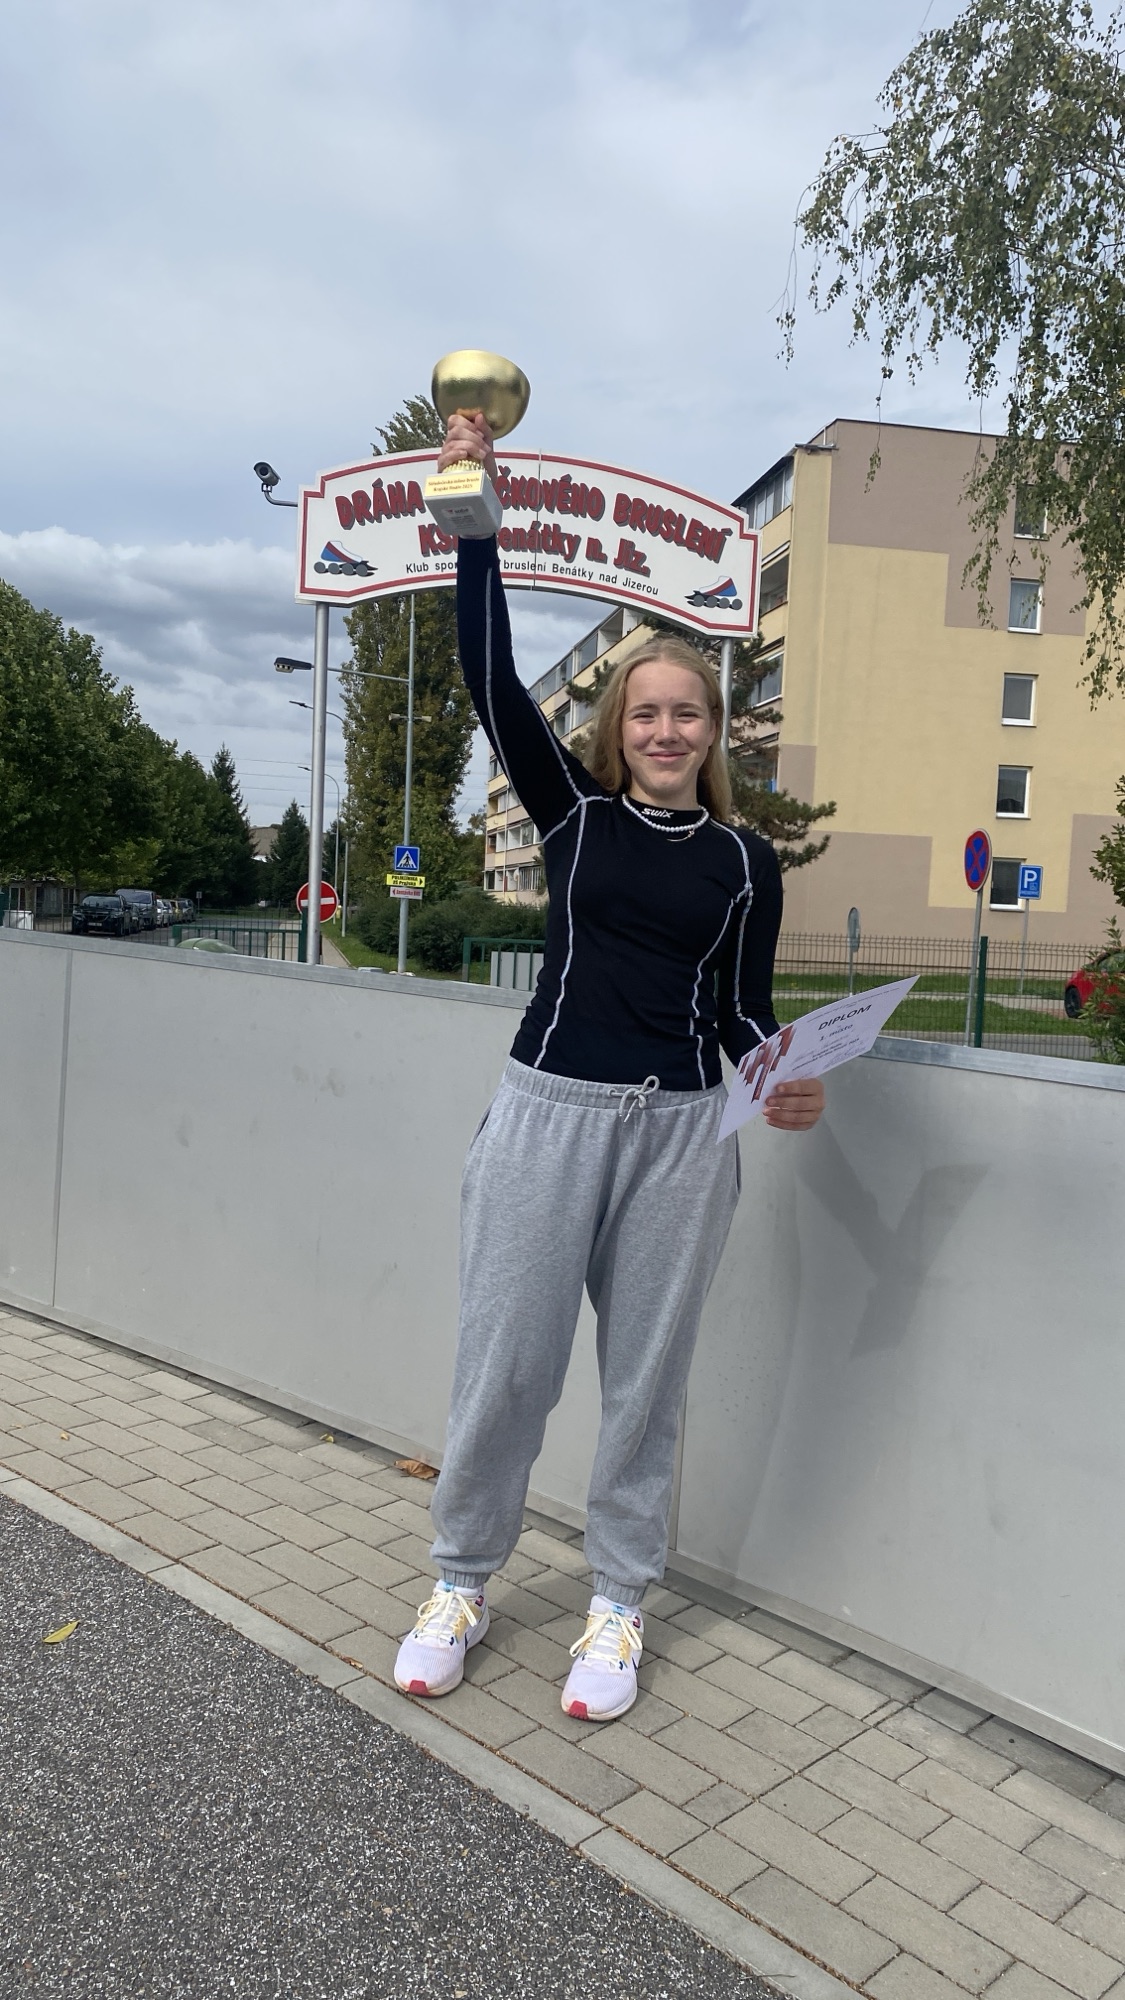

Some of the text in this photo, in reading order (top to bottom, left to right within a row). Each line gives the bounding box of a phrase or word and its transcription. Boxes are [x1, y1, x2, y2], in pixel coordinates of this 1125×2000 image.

[335, 465, 734, 564] DRÁHA ČKOVÉHO BRUSLENÍ
[418, 523, 459, 557] KS
[496, 520, 582, 563] enátky
[586, 537, 608, 565] n.
[614, 538, 652, 578] Jiz.
[406, 562, 429, 574] Klub
[503, 559, 547, 572] bruslení
[552, 563, 594, 582] Benátky
[599, 572, 618, 585] nad
[622, 576, 659, 596] Jizerou
[1023, 870, 1037, 888] P
[818, 1004, 873, 1031] DIPLOM
